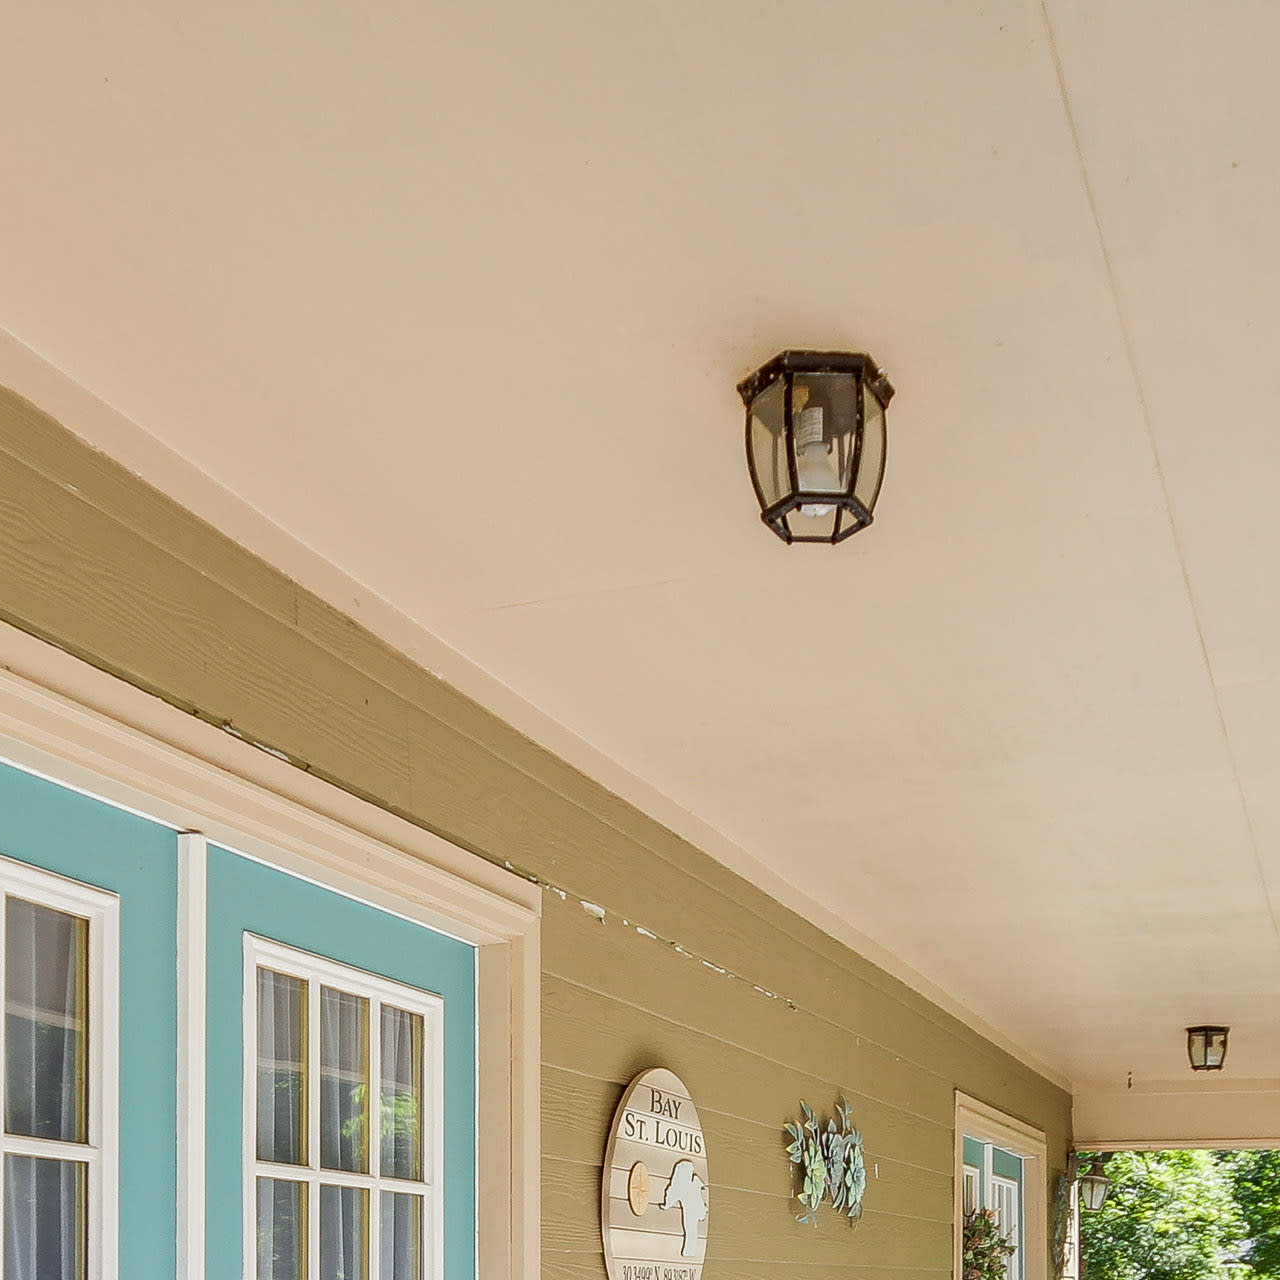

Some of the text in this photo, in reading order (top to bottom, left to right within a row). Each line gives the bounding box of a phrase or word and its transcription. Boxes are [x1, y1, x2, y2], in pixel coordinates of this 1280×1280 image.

[650, 1088, 682, 1120] BAY
[625, 1112, 702, 1154] ST. LOUIS
